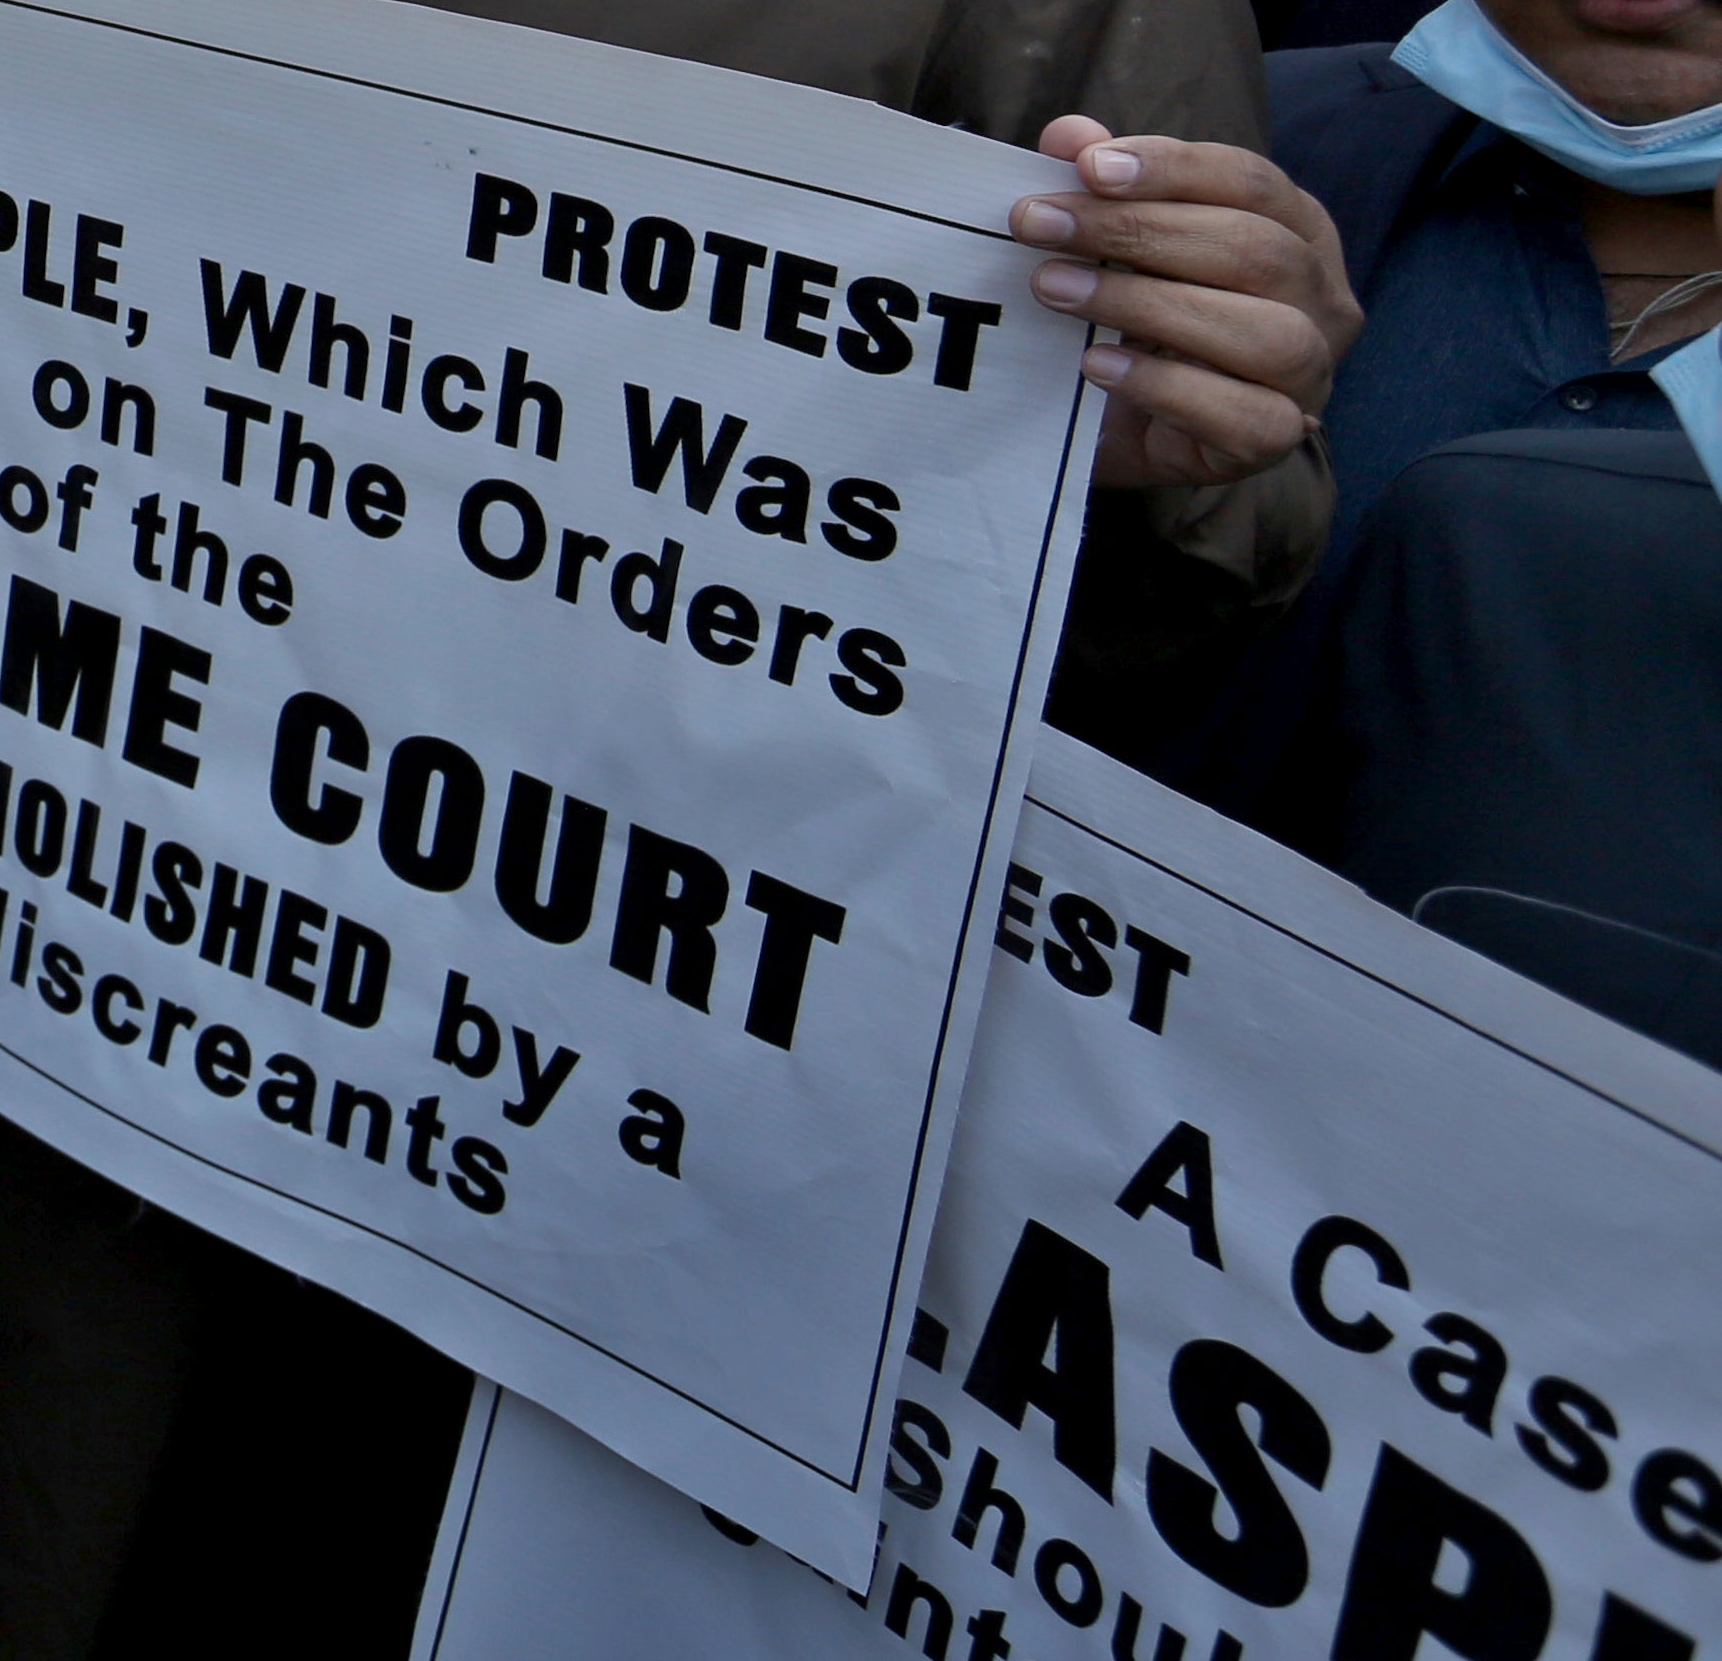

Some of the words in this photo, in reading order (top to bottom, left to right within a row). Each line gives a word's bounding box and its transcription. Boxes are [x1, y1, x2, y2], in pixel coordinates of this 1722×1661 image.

[198, 256, 564, 463] Which
[623, 381, 902, 563] Was
[465, 170, 1003, 393] PROTEST
[31, 358, 156, 458] on
[203, 385, 408, 541] The
[456, 476, 908, 718] Orders
[130, 491, 295, 627] the
[268, 690, 848, 1052] COURT
[995, 860, 1191, 1036] EST
[431, 968, 582, 1129] by
[616, 1086, 687, 1181] a
[1113, 1119, 1225, 1273] A
[1290, 1213, 1722, 1565] Case
